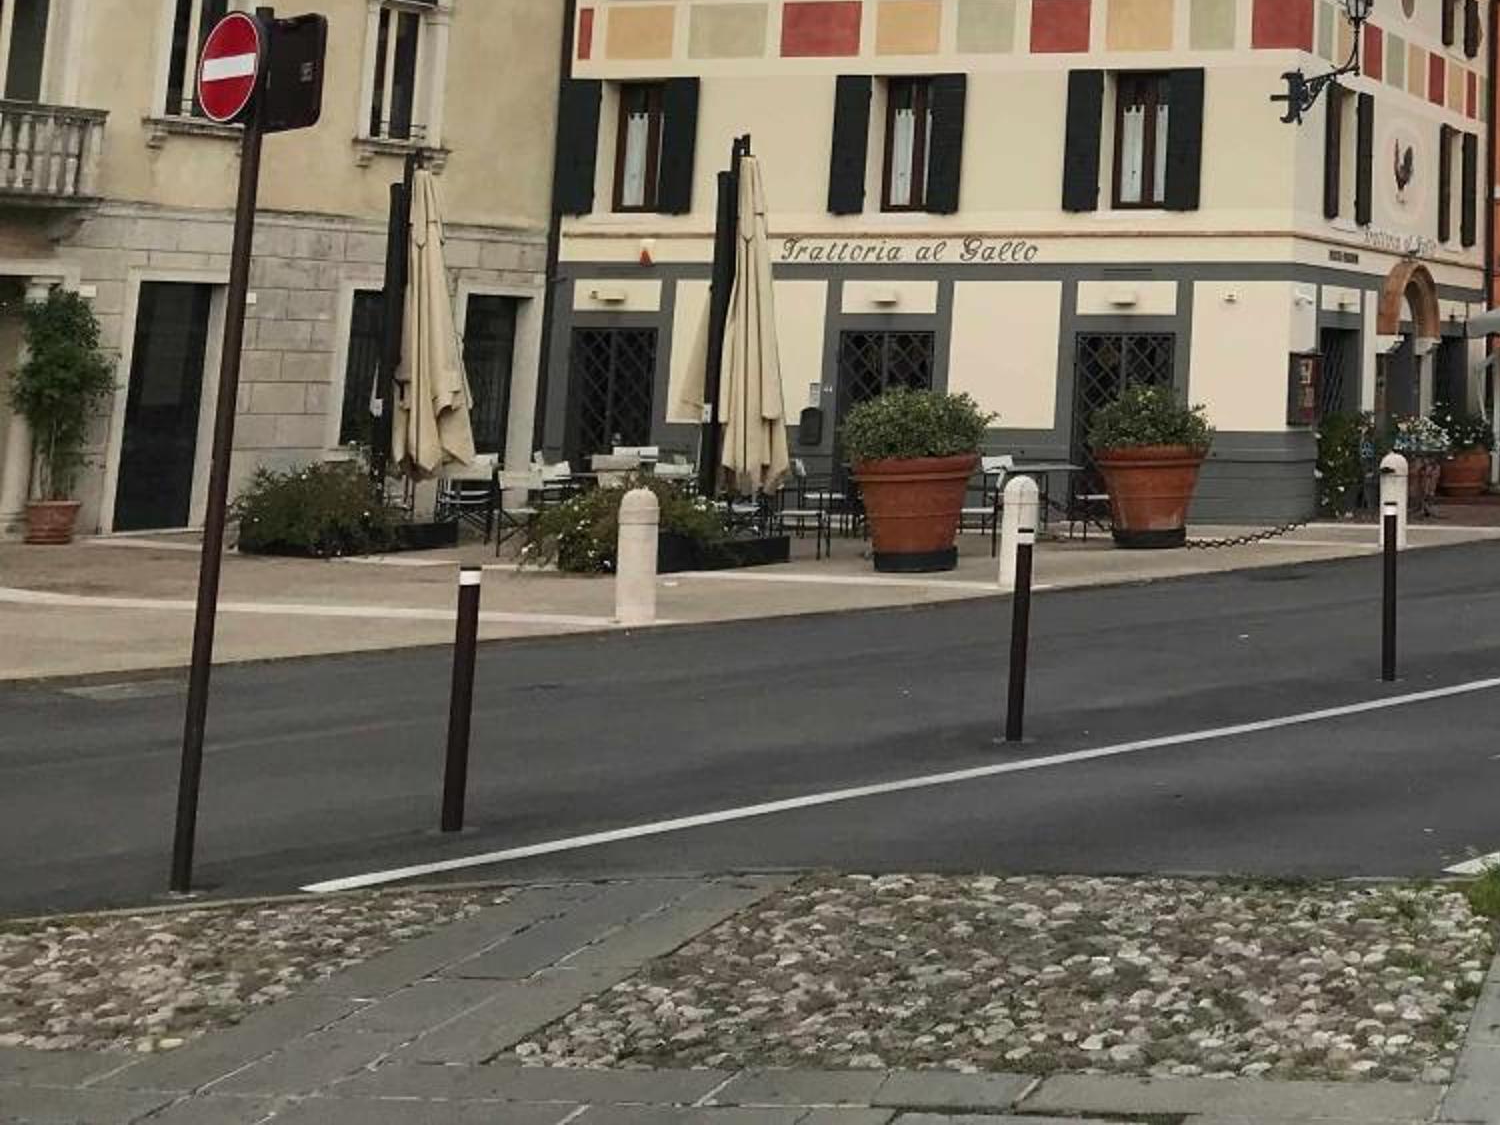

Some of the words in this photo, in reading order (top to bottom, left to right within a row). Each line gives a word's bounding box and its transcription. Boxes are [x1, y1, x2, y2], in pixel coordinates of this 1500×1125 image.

[781, 237, 902, 262] Trattoria
[915, 240, 947, 262] al
[959, 236, 1039, 262] Gallo
